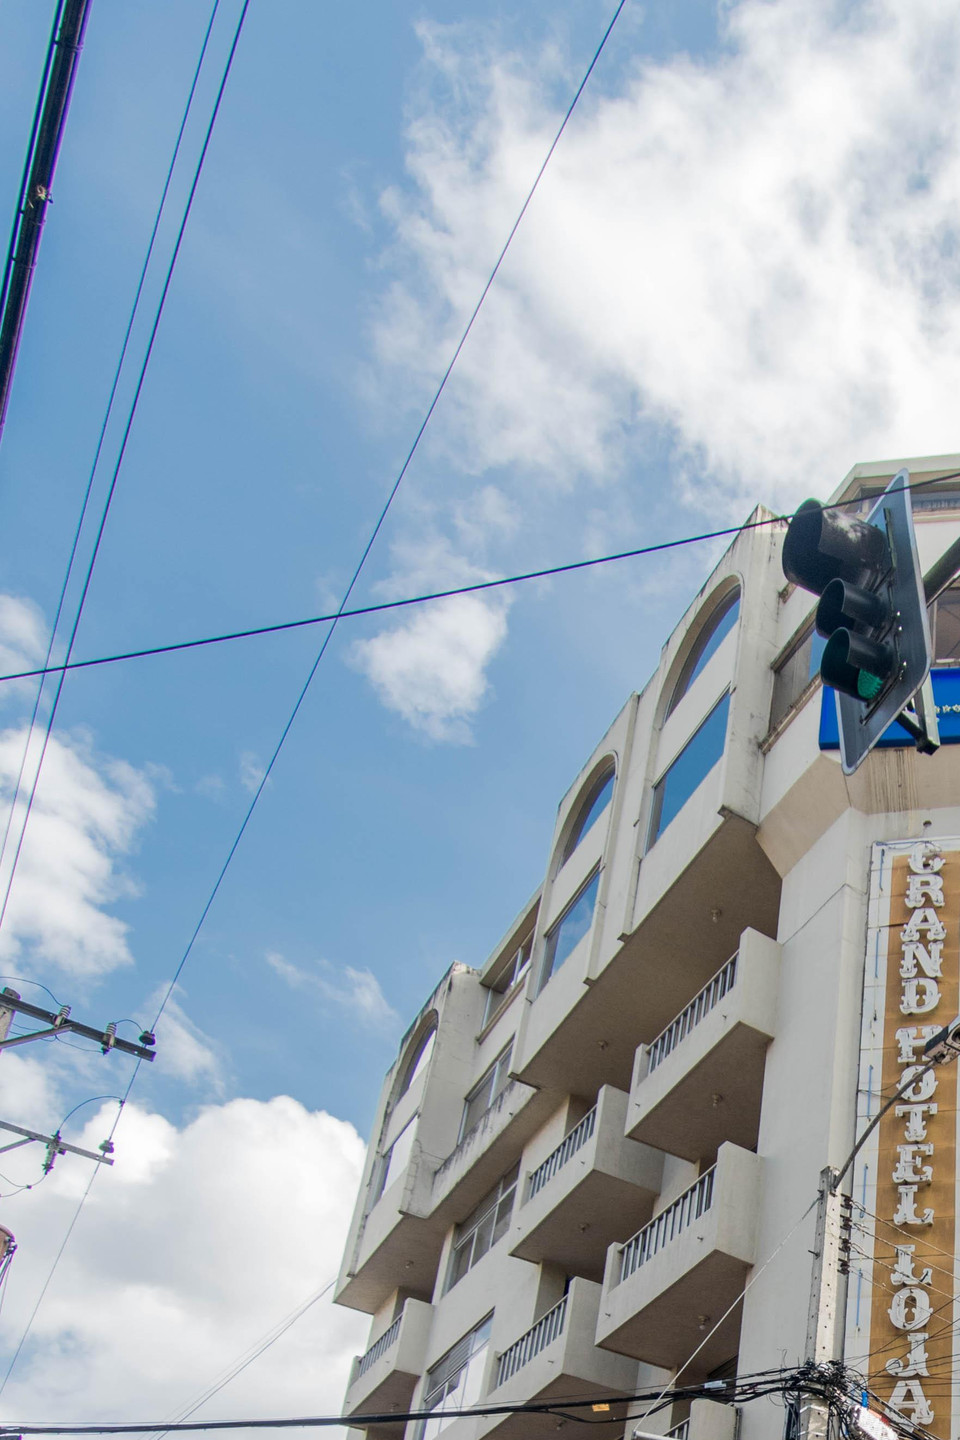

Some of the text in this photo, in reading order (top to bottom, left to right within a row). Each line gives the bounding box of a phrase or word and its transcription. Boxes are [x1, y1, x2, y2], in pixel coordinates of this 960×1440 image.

[884, 841, 947, 1433] GRAND HOTEL LOJA
